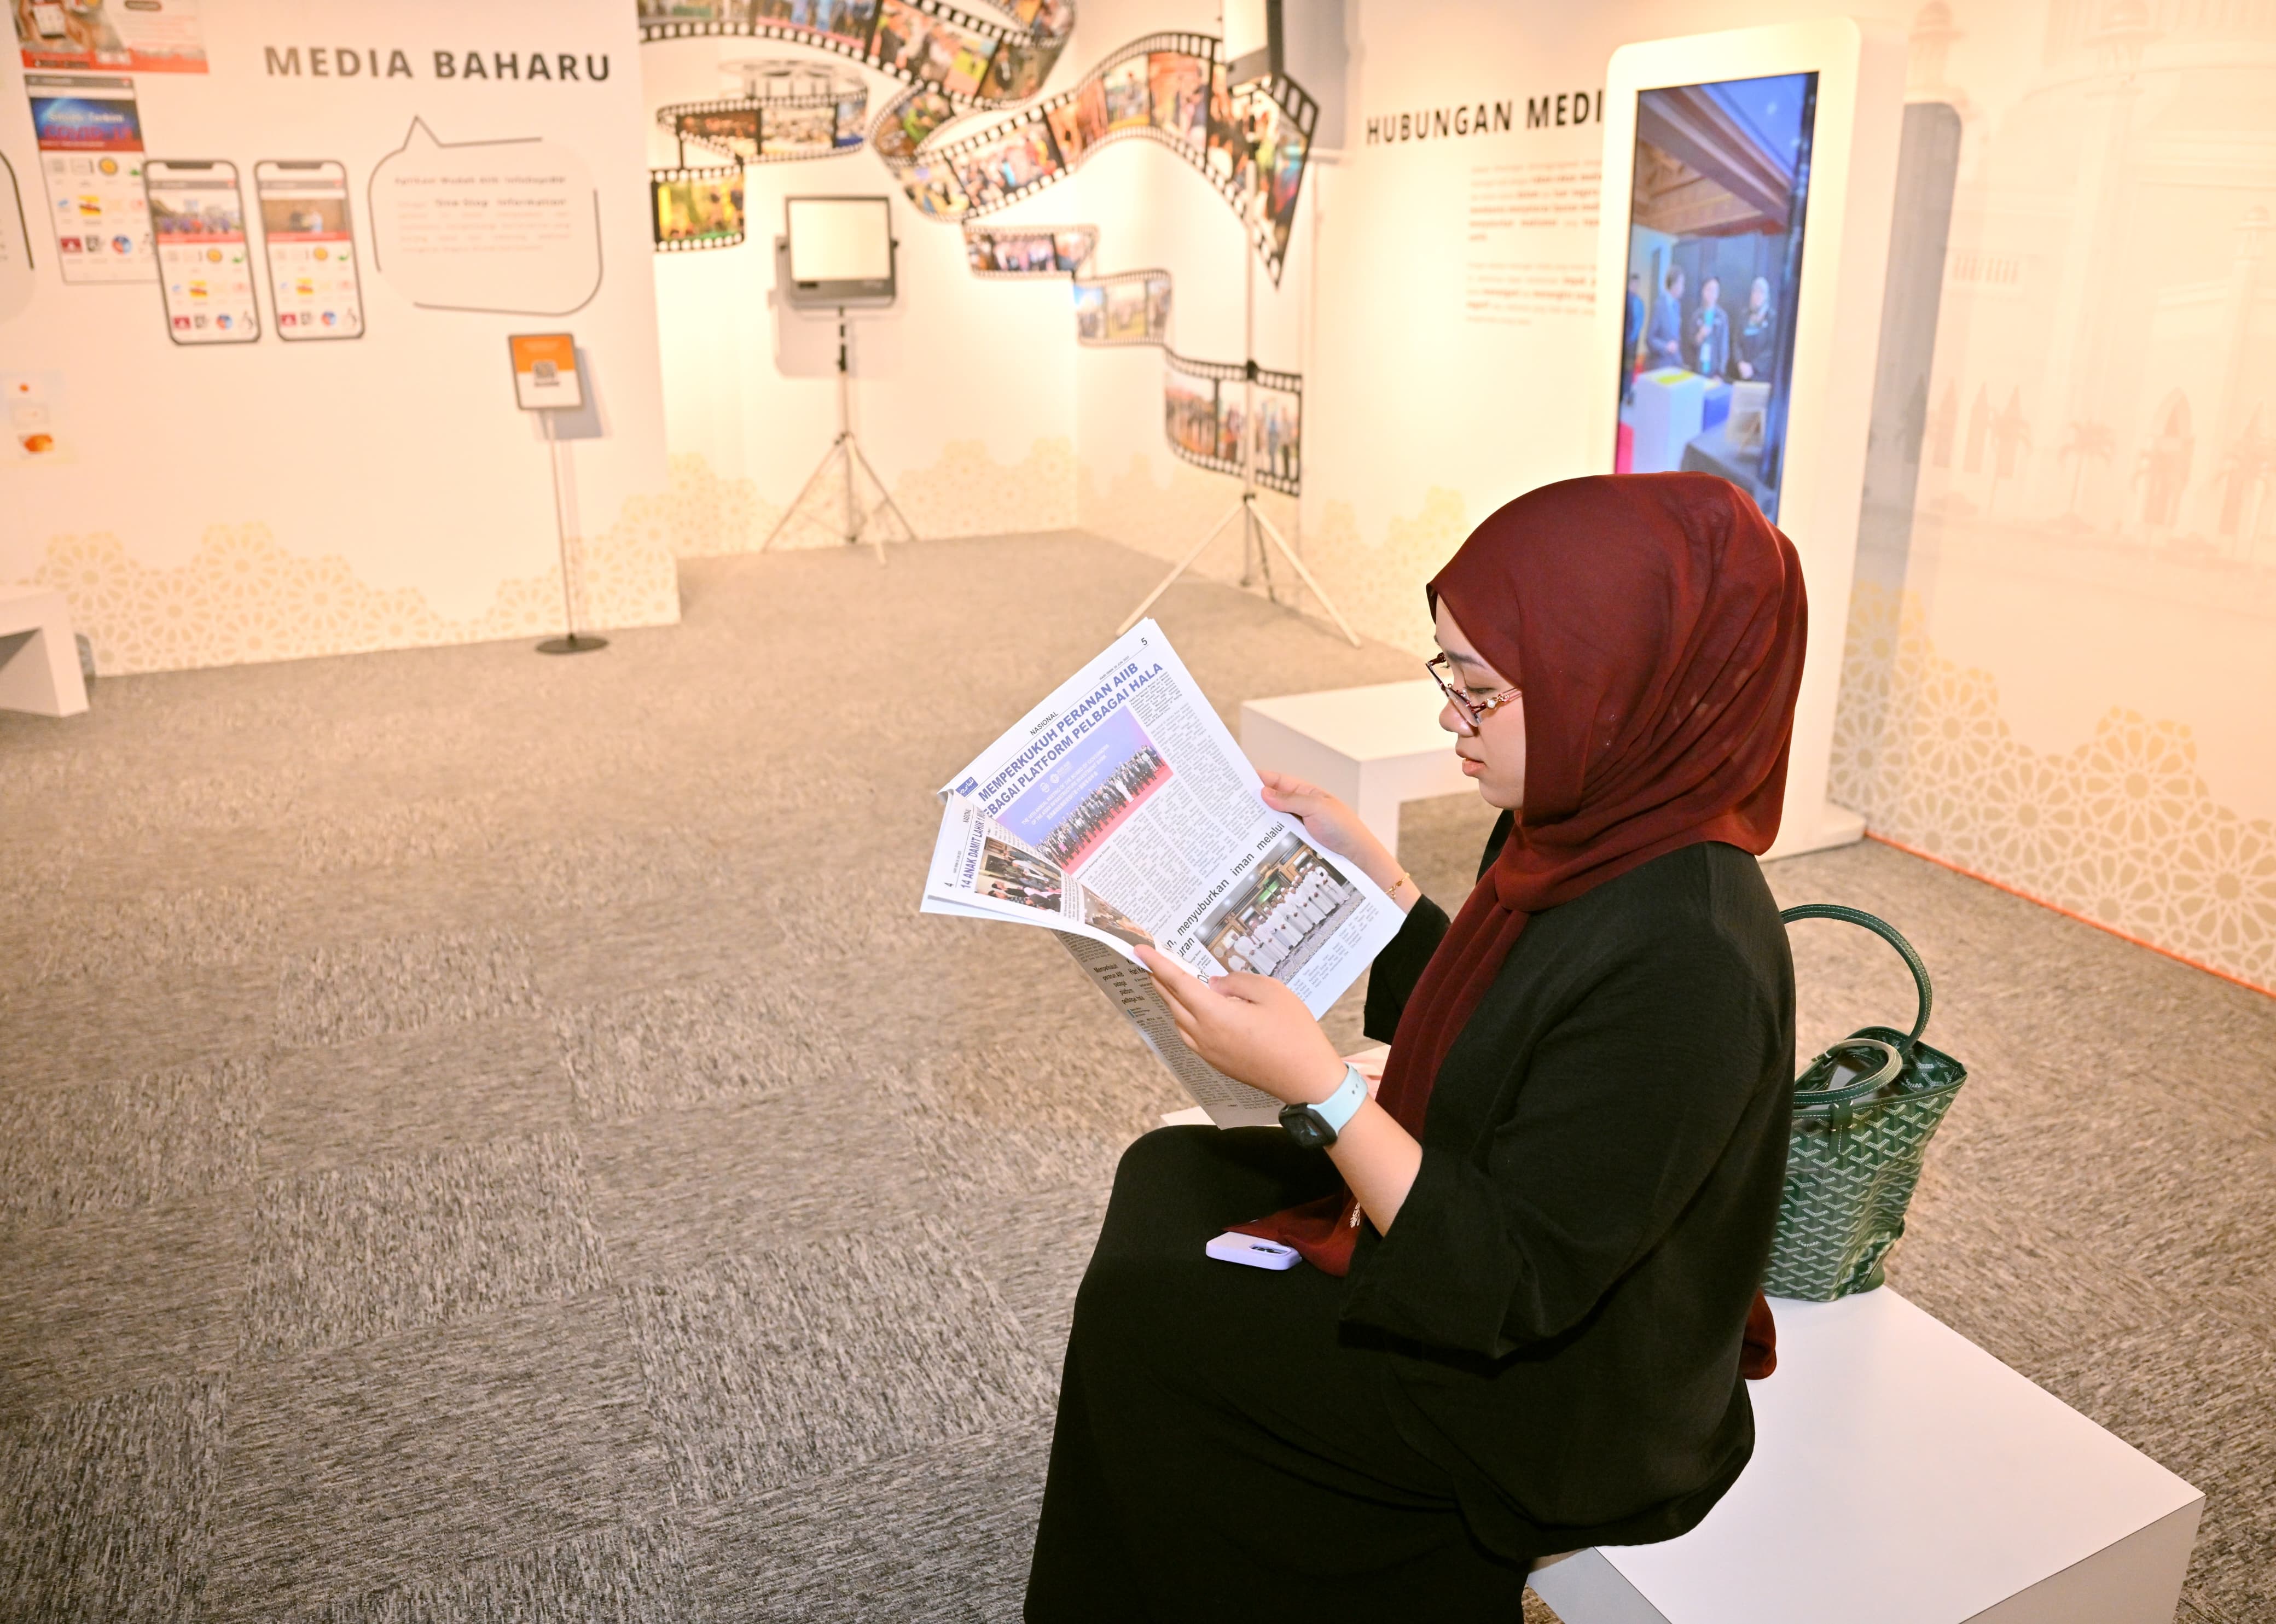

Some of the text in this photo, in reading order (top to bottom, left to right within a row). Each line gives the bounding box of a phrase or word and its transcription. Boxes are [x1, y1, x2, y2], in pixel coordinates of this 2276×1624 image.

[264, 46, 611, 82] MEDIA BAHARU
[1366, 89, 1603, 145] HUBUNGAN MEDI
[978, 729, 1058, 801] MEMPERKUKUH
[1056, 683, 1112, 732] PERANAN
[1113, 663, 1137, 687] AIIB
[1030, 712, 1058, 735] NASIONAL
[983, 784, 1020, 818] EBAGAI
[1018, 736, 1073, 787] PLATFORM
[1072, 689, 1129, 739] PELBAGAI
[1129, 663, 1163, 692] HALA
[973, 820, 985, 838] LAHIR
[968, 837, 982, 858] DAMIT
[963, 858, 977, 879] ANAK
[1177, 880, 1229, 936] menyuburkan
[1230, 854, 1254, 876] iman
[1257, 822, 1285, 851] melalui
[960, 879, 972, 888] 14
[1177, 938, 1194, 957] uran
